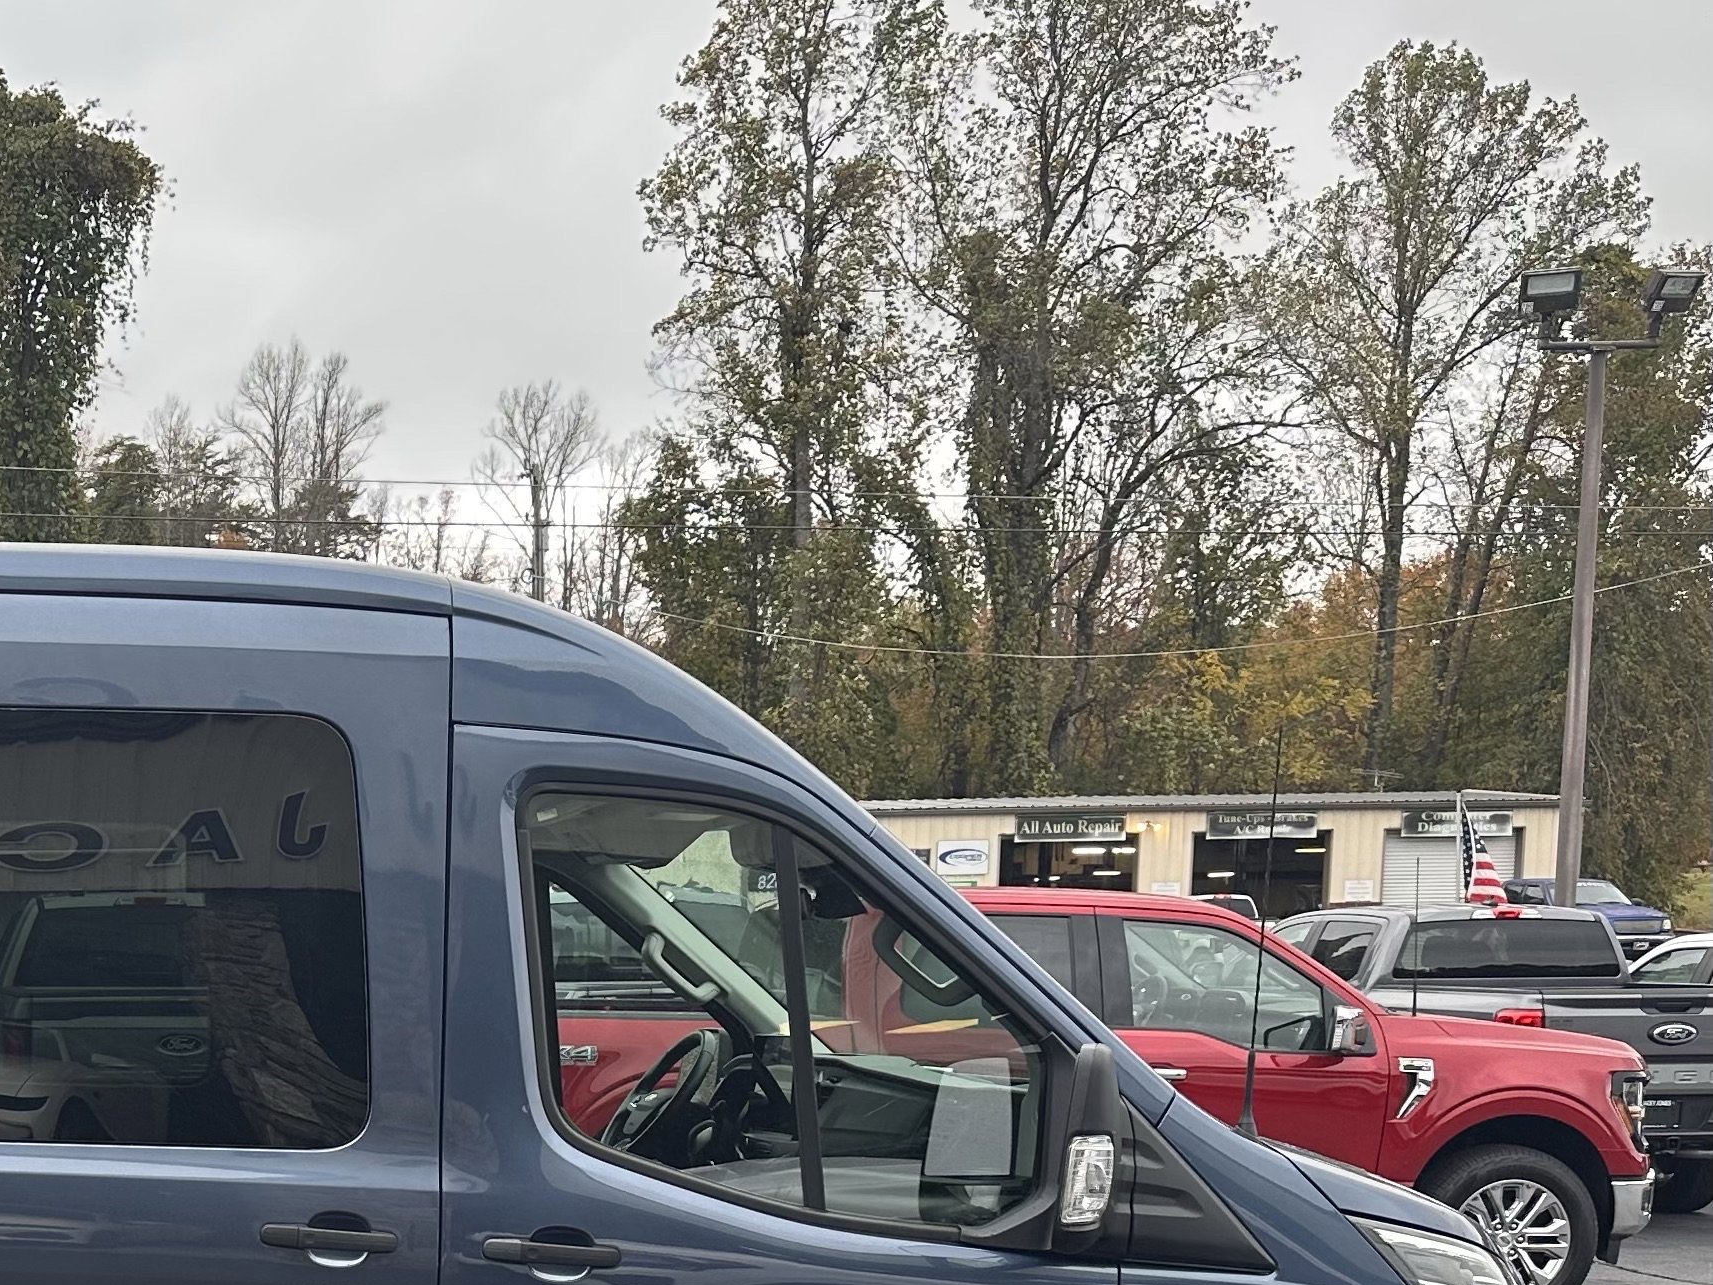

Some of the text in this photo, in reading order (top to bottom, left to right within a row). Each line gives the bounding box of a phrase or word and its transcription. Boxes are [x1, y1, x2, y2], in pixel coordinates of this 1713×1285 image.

[1019, 819, 1122, 836] All Auto Repair
[1417, 822, 1497, 834] Diagntics
